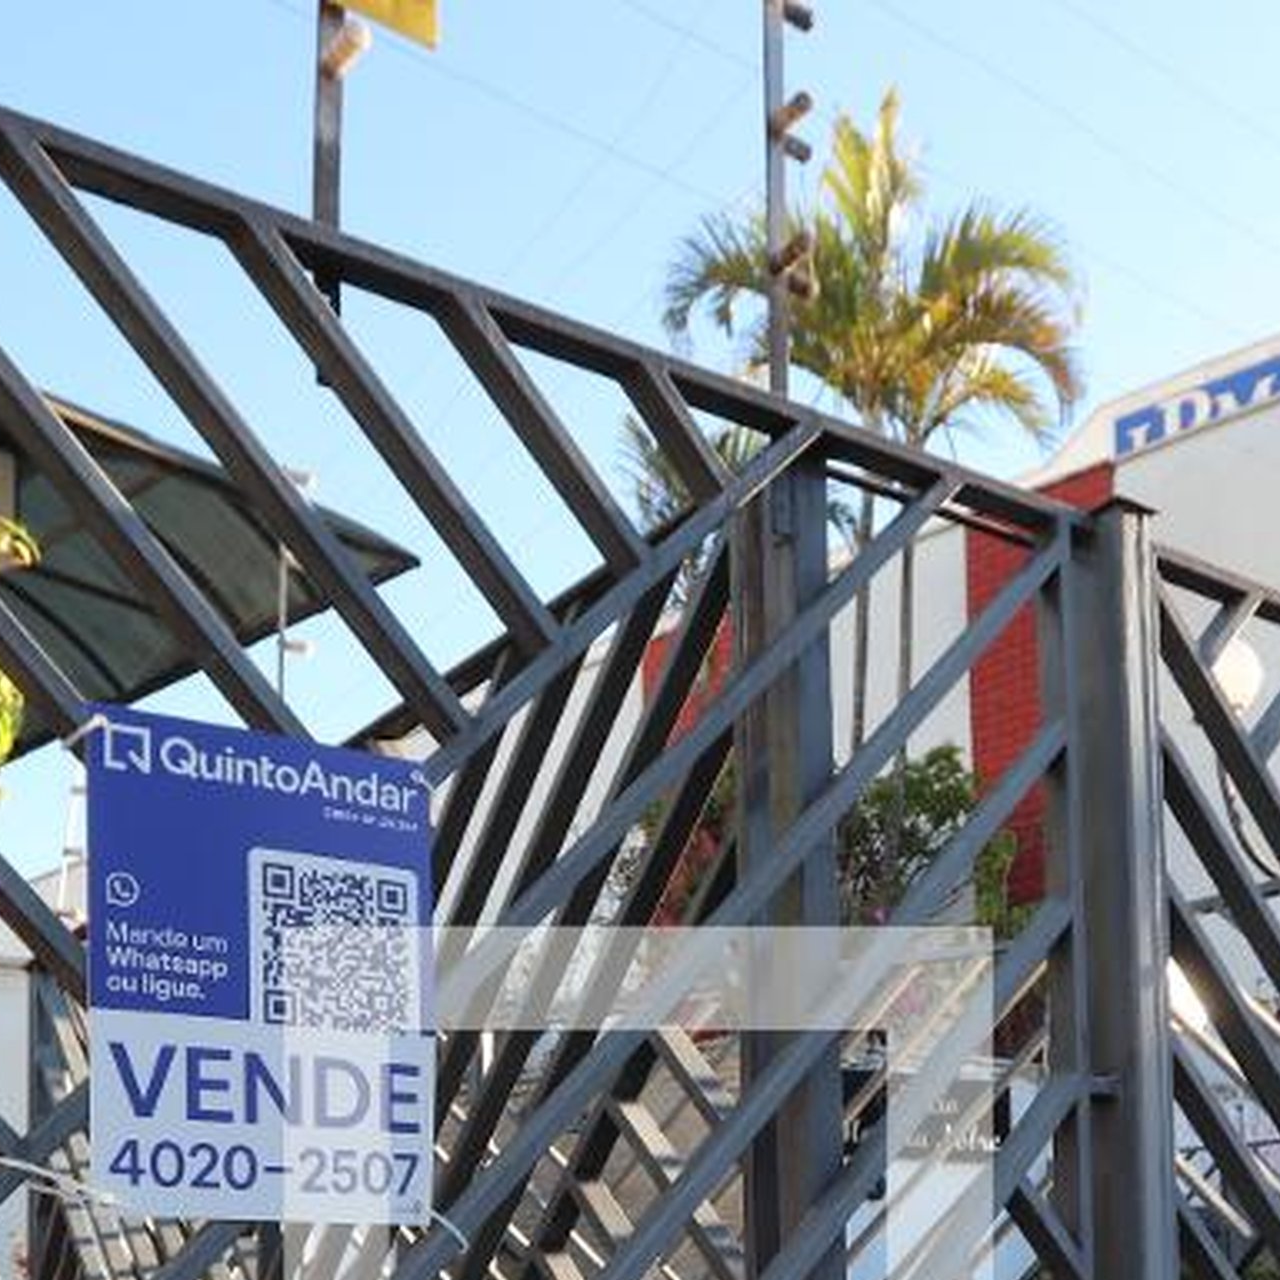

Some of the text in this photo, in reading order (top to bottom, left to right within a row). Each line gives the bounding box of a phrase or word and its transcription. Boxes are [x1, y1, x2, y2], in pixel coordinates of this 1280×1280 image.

[159, 735, 419, 814] QuintoAndar
[105, 945, 229, 981] Whatsapp
[192, 934, 228, 954] um
[105, 974, 138, 993] ou
[107, 1041, 421, 1134] VENDE
[108, 1138, 421, 1196] 4020-2507
